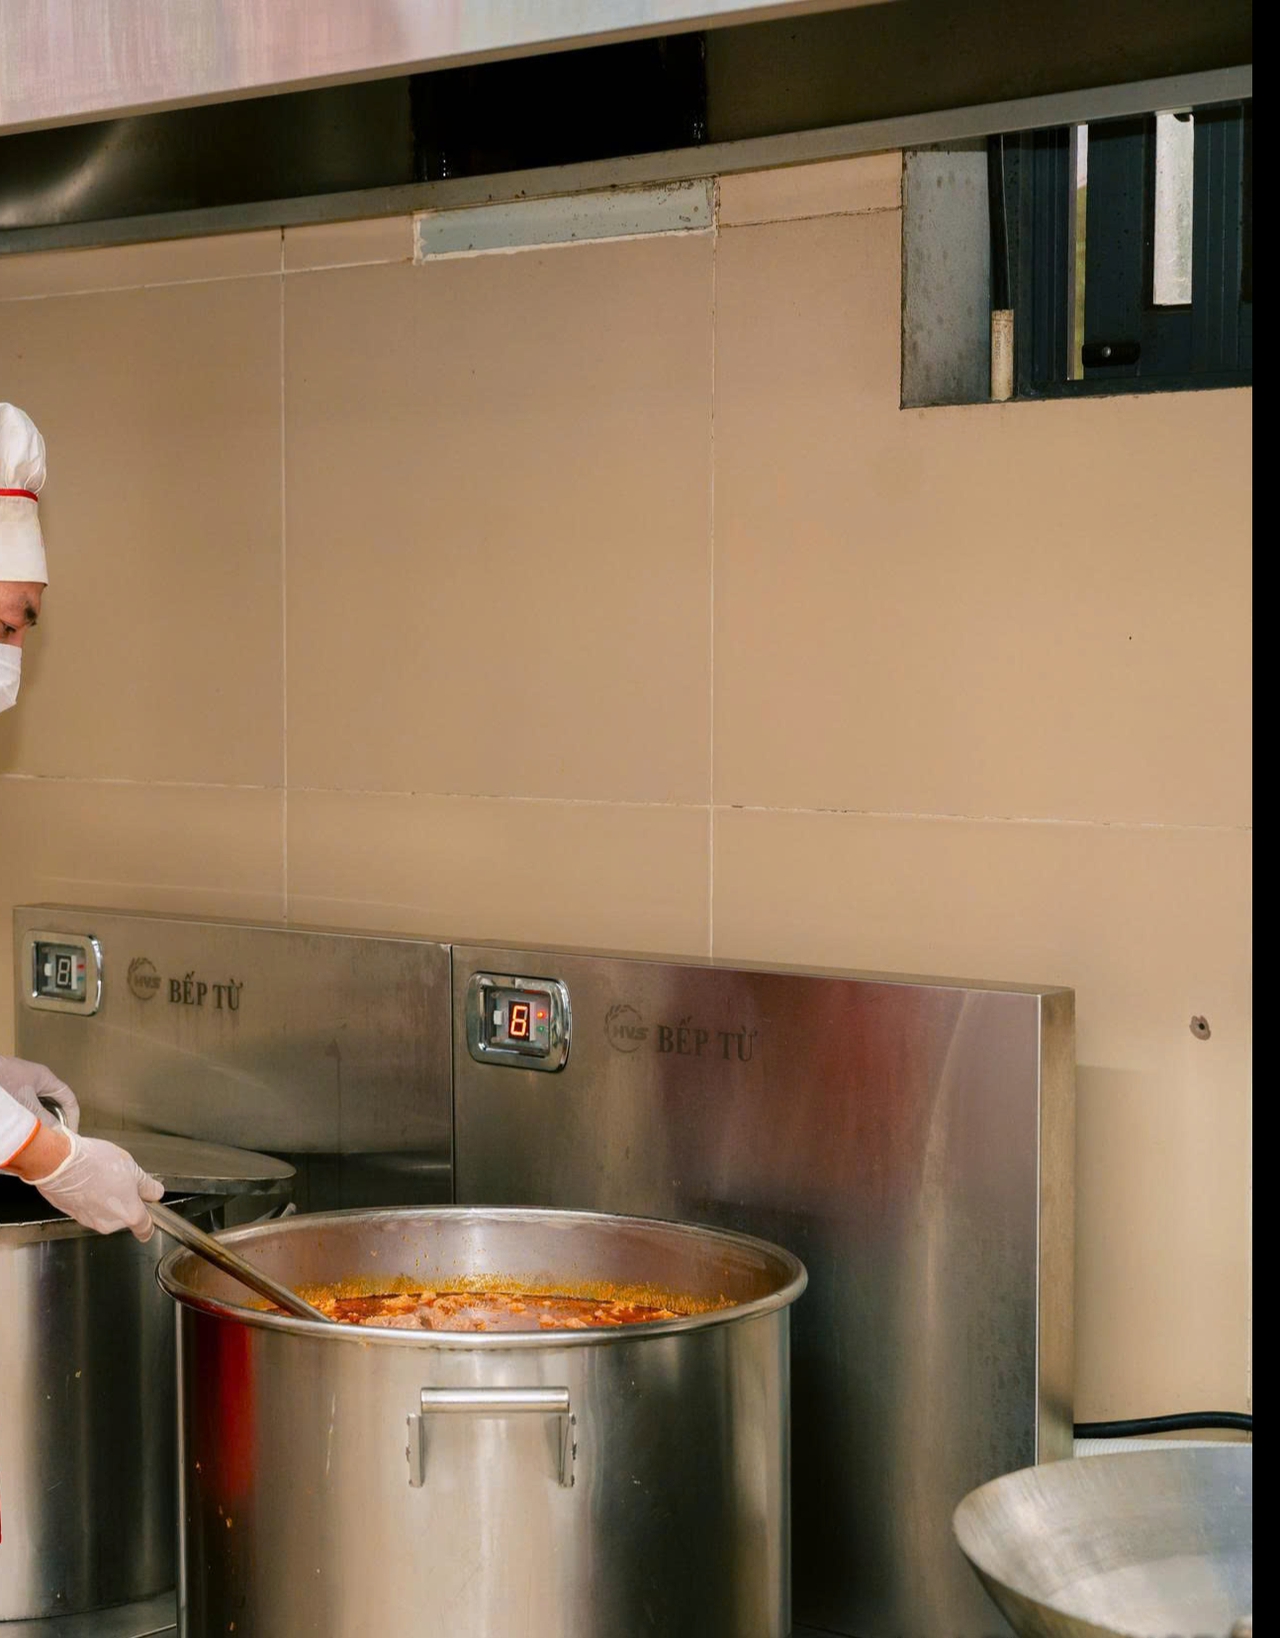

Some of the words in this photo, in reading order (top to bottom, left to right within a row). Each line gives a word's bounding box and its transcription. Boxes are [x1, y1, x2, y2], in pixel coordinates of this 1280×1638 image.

[168, 970, 208, 1007] BẾP
[212, 978, 244, 1011] TỪ
[657, 1014, 708, 1057] BẾP
[718, 1025, 759, 1062] TỪ
